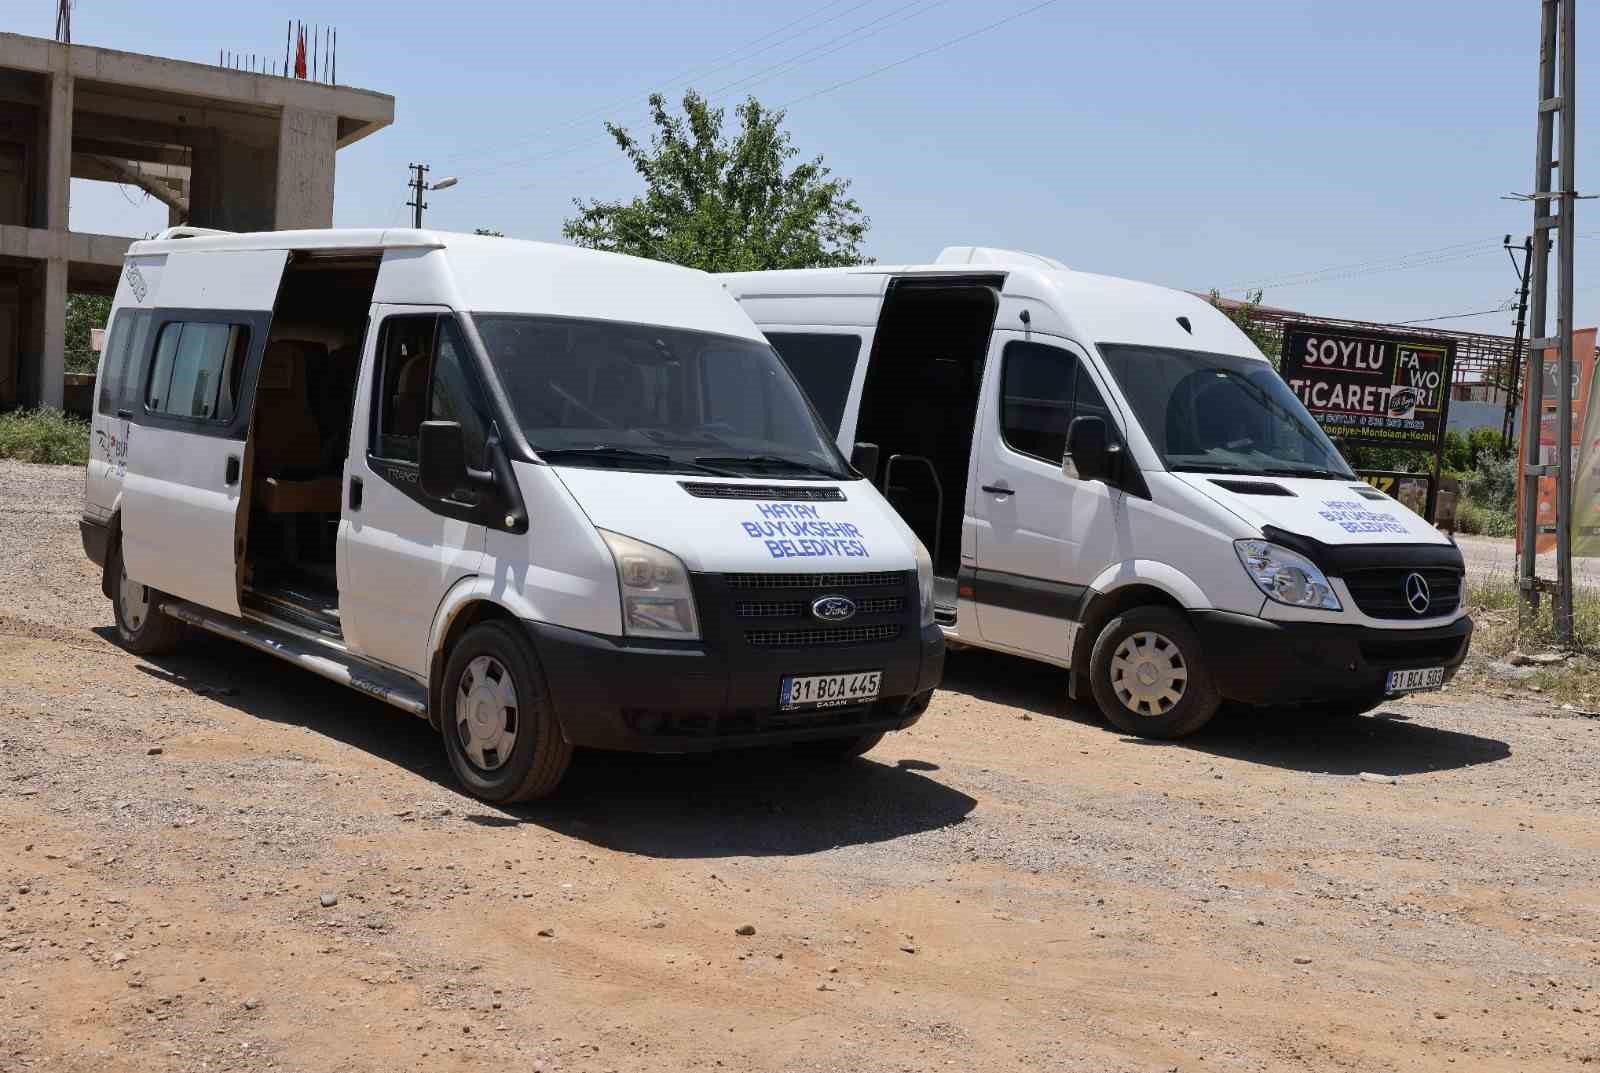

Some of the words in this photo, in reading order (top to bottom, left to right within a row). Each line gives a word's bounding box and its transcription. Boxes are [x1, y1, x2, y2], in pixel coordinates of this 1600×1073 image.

[1304, 337, 1385, 369] SOYLU
[1399, 350, 1420, 370] FA
[1410, 369, 1440, 389] WO
[756, 503, 821, 519] HATAY
[824, 599, 848, 616] Ford
[793, 680, 811, 701] 31
[817, 677, 846, 699] BCA
[849, 674, 878, 695] 445
[1392, 671, 1404, 689] 31
[1406, 671, 1423, 688] BCA
